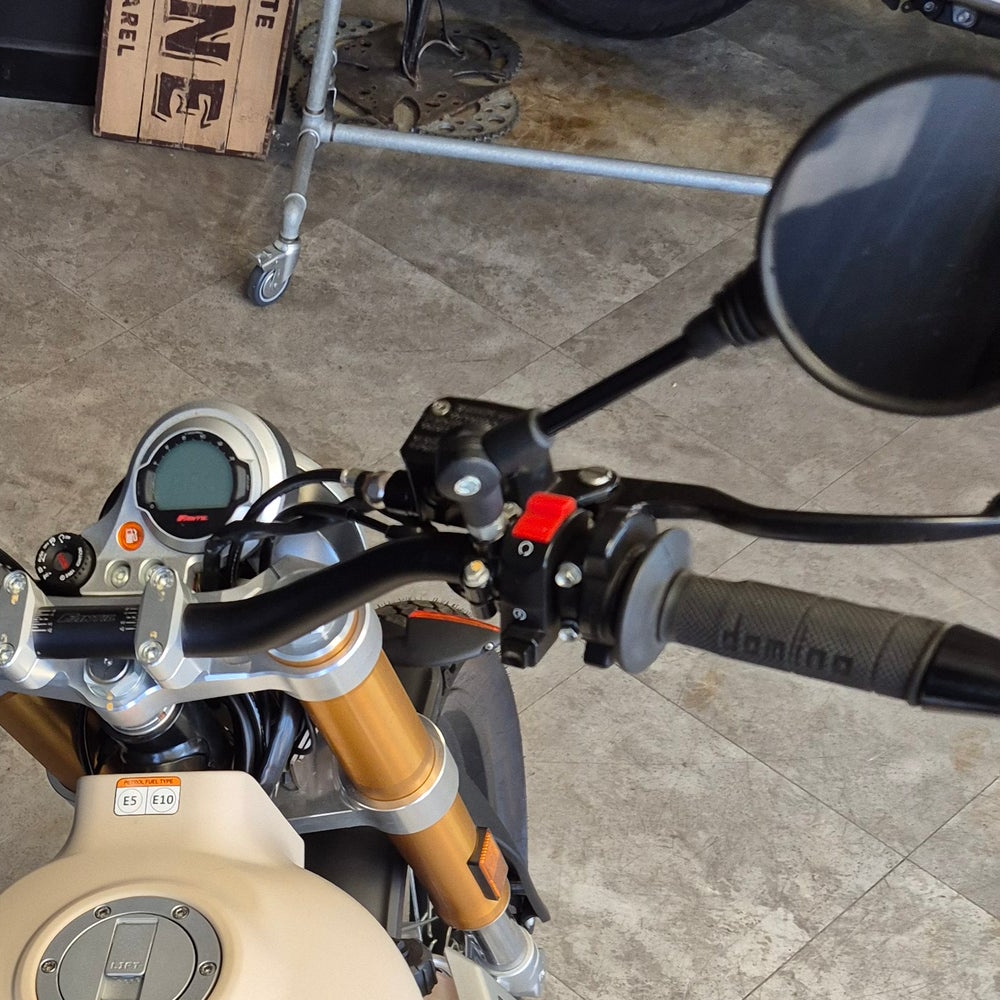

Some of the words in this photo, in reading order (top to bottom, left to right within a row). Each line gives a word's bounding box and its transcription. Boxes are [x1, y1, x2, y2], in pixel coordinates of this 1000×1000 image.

[123, 796, 137, 806] E5
[152, 795, 174, 805] E10
[110, 961, 140, 970] LIFT
